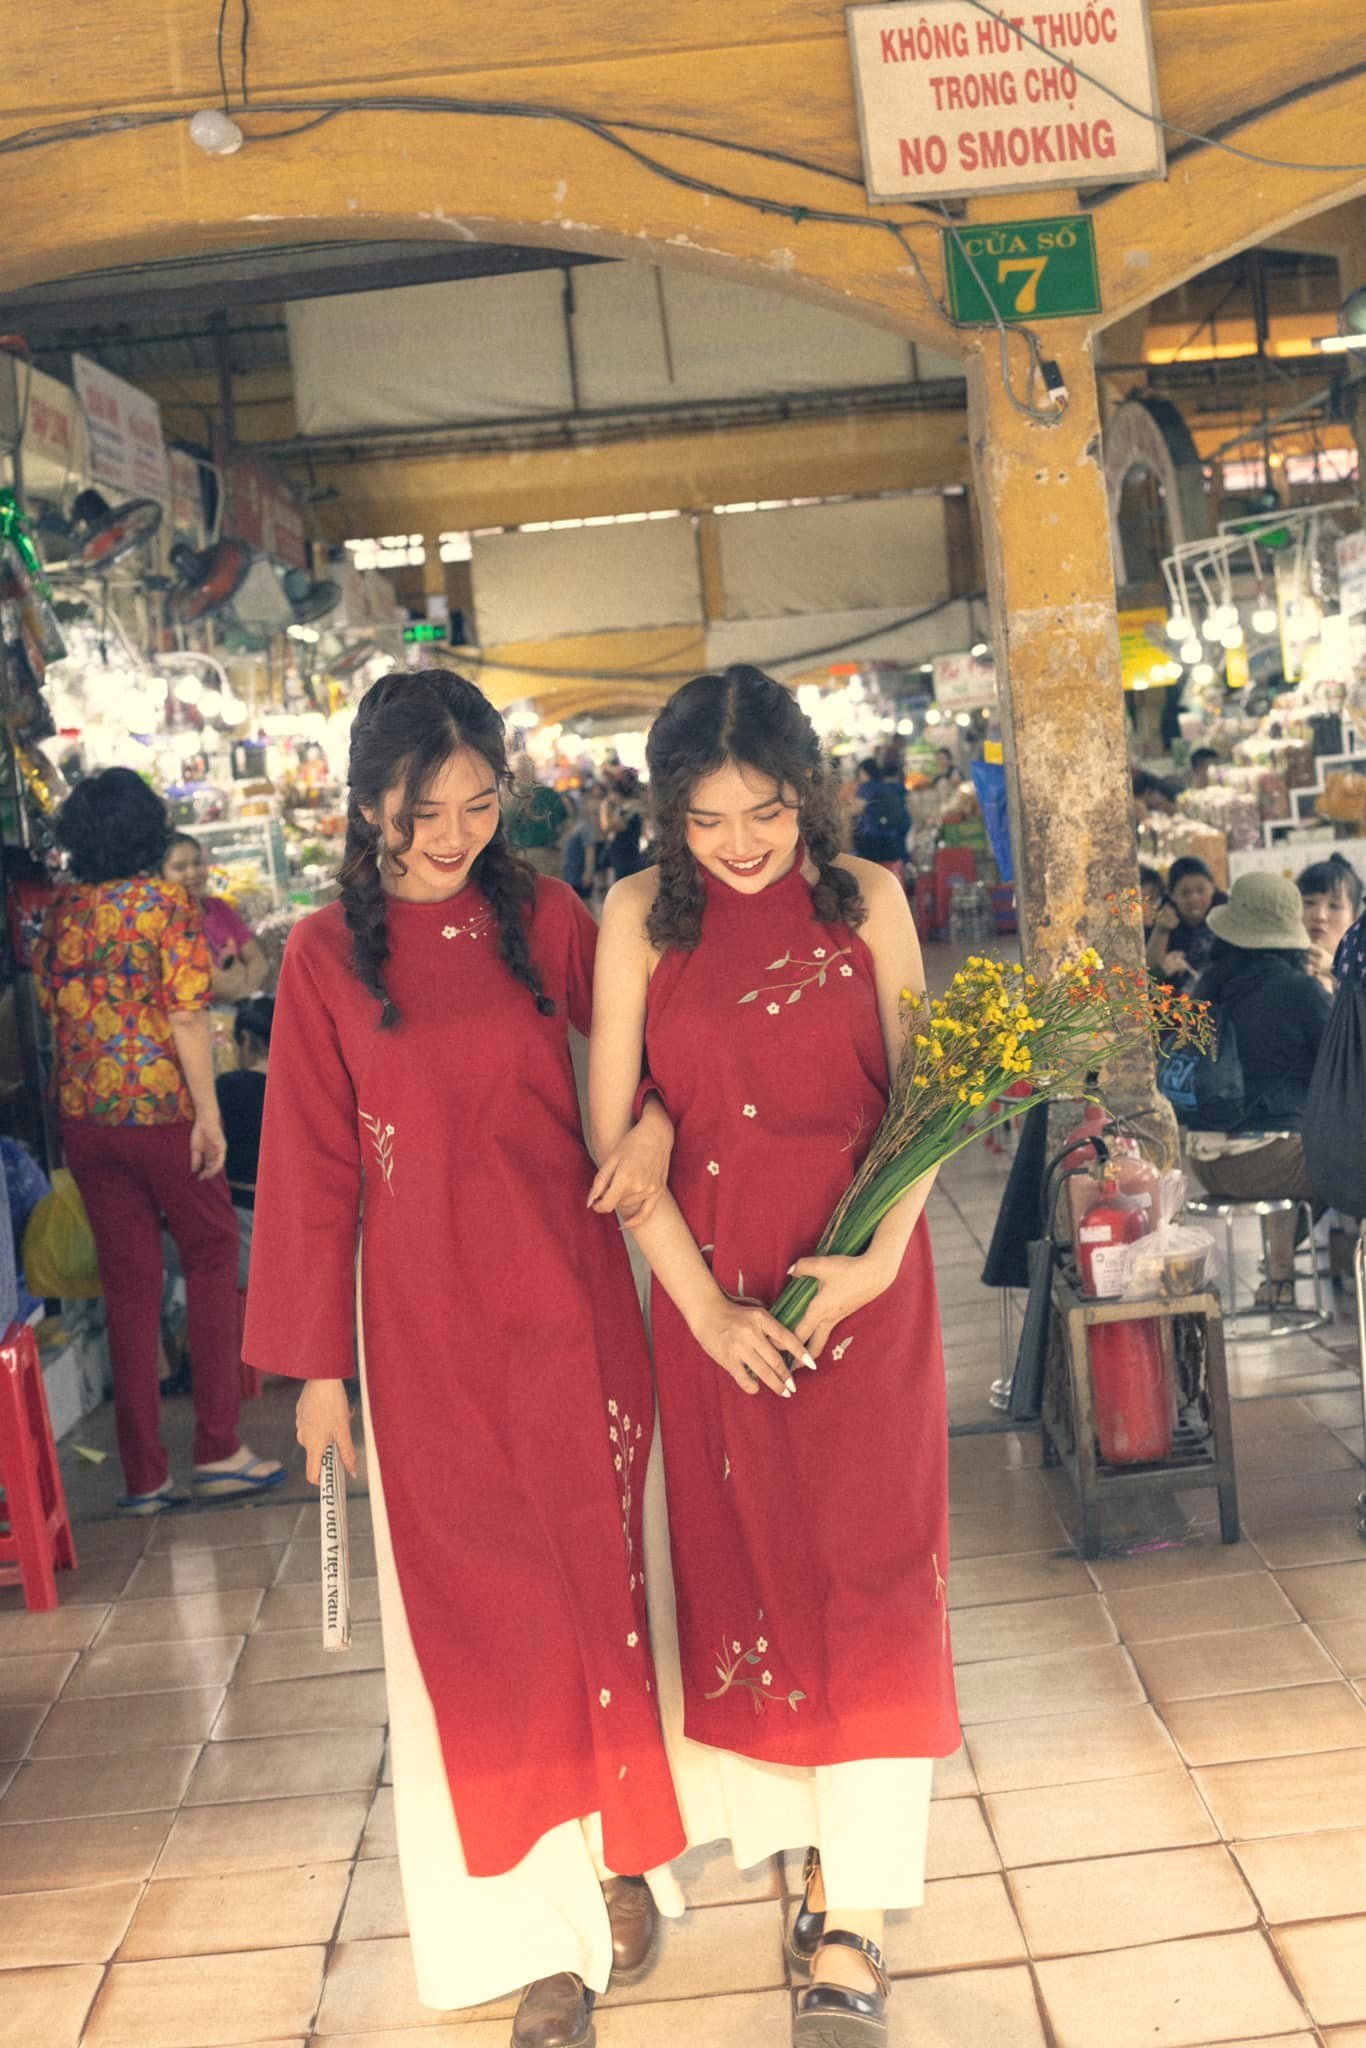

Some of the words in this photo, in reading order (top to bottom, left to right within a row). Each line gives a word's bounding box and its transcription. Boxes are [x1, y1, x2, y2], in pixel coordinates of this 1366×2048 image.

[880, 18, 969, 63] KHÔNG
[976, 10, 1024, 55] HÚT
[1032, 0, 1117, 47] THUỐC
[930, 69, 1016, 110] TRONG
[1024, 58, 1077, 109] CHỢ
[899, 134, 947, 176] NO
[958, 119, 1116, 171] SMOKING
[1038, 225, 1076, 251] SỐ
[997, 256, 1048, 313] 7
